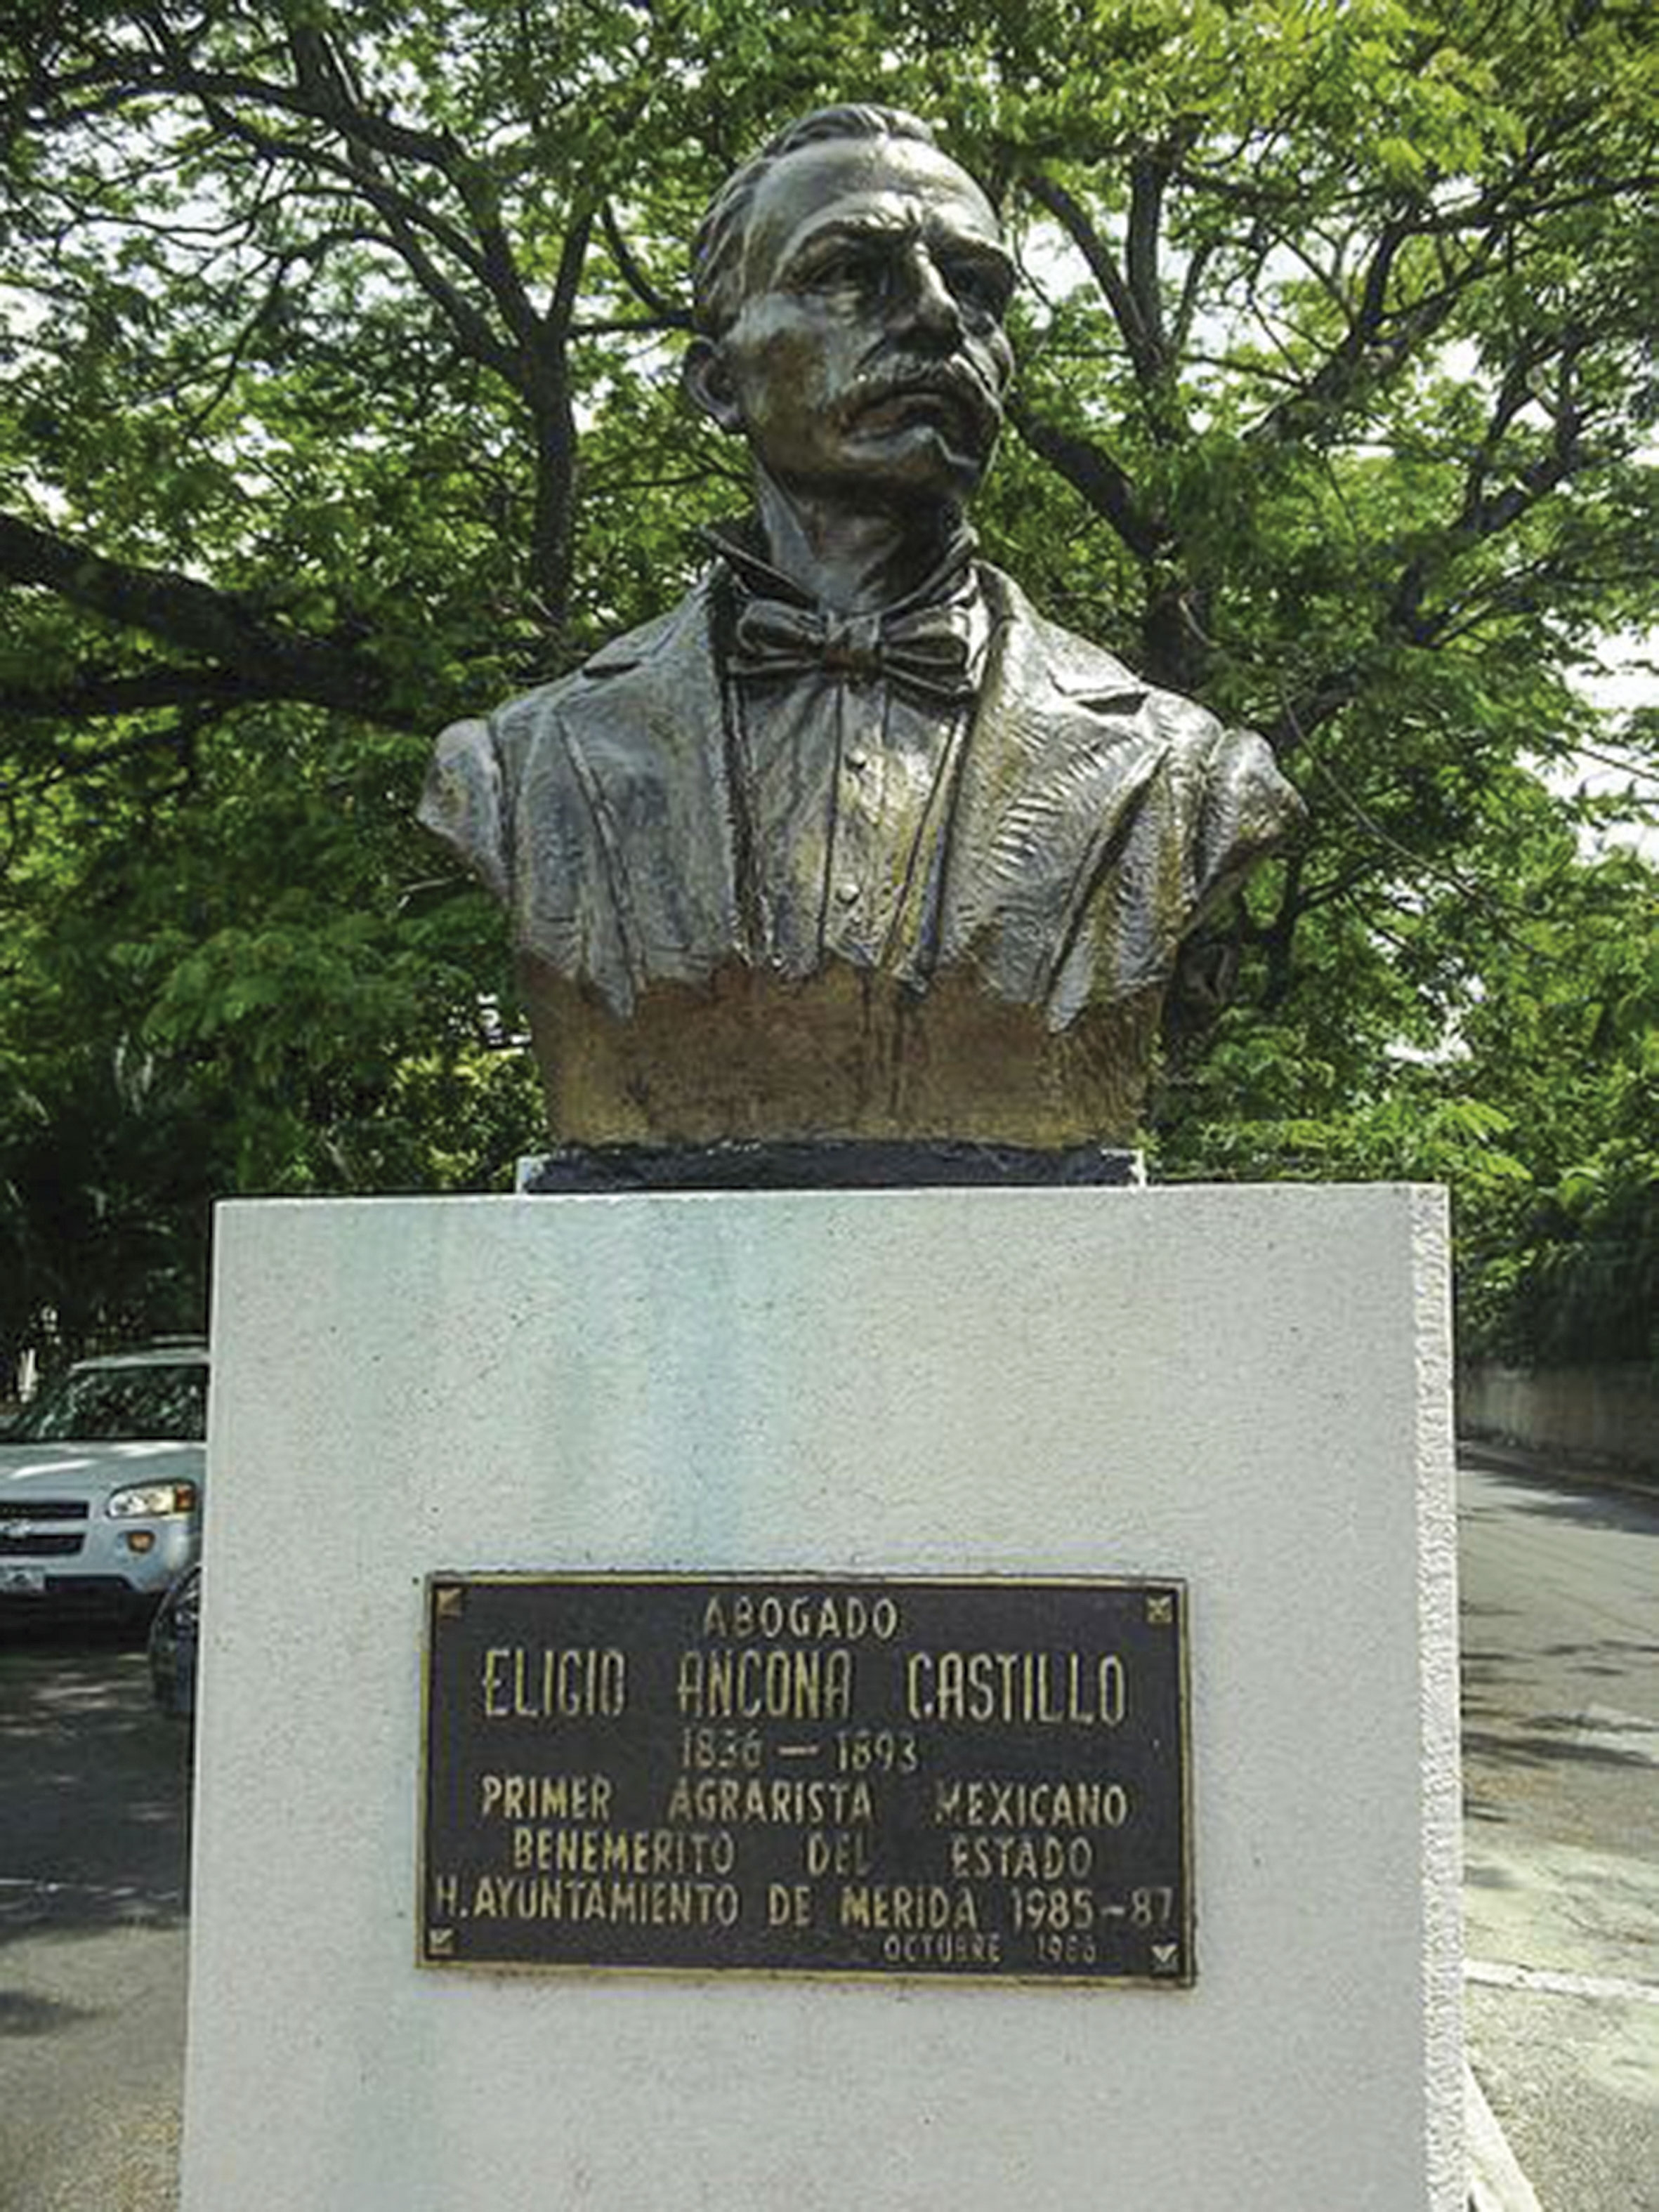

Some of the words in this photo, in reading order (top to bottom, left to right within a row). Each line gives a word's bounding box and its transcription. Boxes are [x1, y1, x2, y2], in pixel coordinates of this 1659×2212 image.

[704, 1596, 898, 1640] ABOGADO
[483, 1648, 625, 1718] ELIGIO
[678, 1649, 851, 1718] ANCONA
[909, 1652, 1124, 1725] CASTILLO
[836, 1730, 918, 1772] 1893
[483, 1775, 612, 1820] PRIMER
[669, 1778, 874, 1823] AGRARISTA
[936, 1782, 1127, 1827] MEXICANO
[514, 1826, 735, 1875] BENEMERITO
[808, 1832, 871, 1876] DEL
[951, 1836, 1093, 1879] ESTADO
[768, 1882, 812, 1925] DE
[841, 1885, 978, 1930] MERIDA
[884, 1933, 1001, 1963] OCTUBRE
